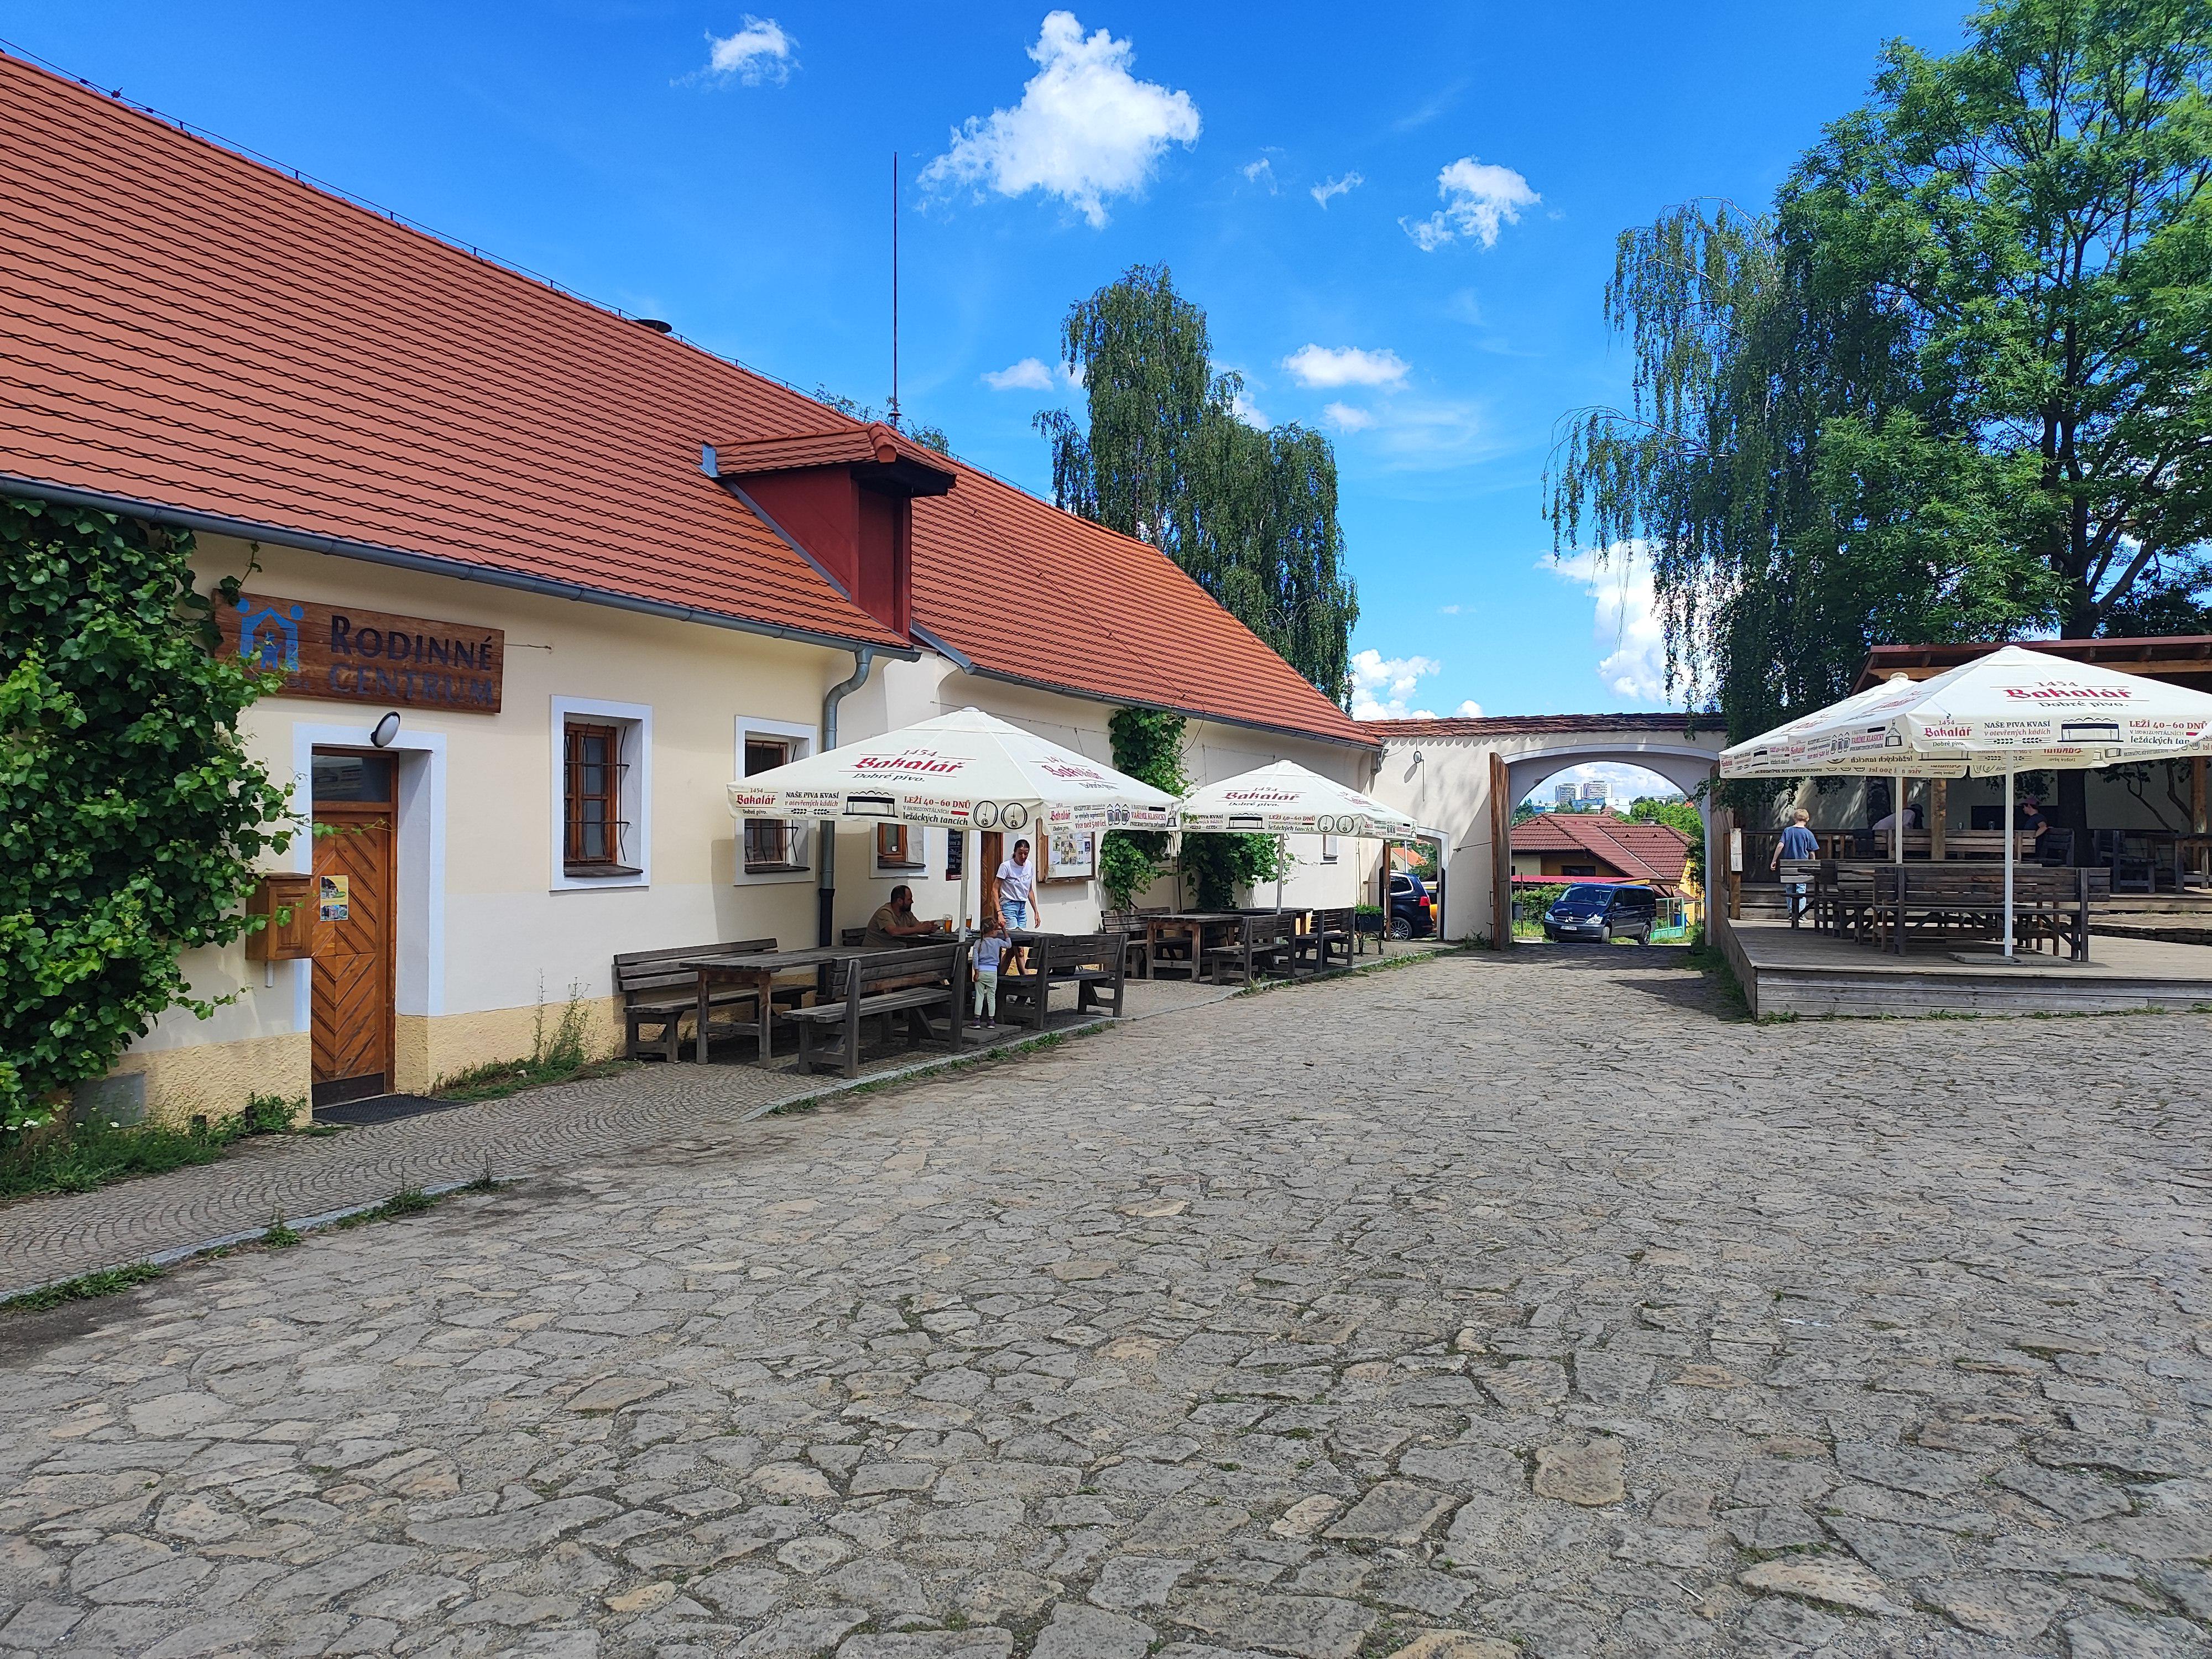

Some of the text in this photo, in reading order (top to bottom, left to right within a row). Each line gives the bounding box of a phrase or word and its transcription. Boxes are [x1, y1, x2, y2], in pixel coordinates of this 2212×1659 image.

[331, 615, 493, 671] RODINNÉ
[330, 663, 494, 706] CENTRUM
[2002, 688, 2132, 698] Bakalář
[2129, 719, 2151, 728] LEŽÍ
[1923, 726, 1972, 737] Bakalář
[2131, 736, 2173, 746] ležáckých
[851, 757, 966, 773] Bakalář
[736, 794, 776, 805] Bakalář
[786, 790, 801, 799] NAŠE
[1221, 792, 1301, 801] Bakalář
[789, 800, 819, 808] otevřených
[904, 795, 922, 804] LEŽÍ
[952, 799, 971, 809] DNŮ
[907, 806, 950, 815] HORIZONTÁLNÍCH
[902, 811, 968, 826] ležáckých tancích
